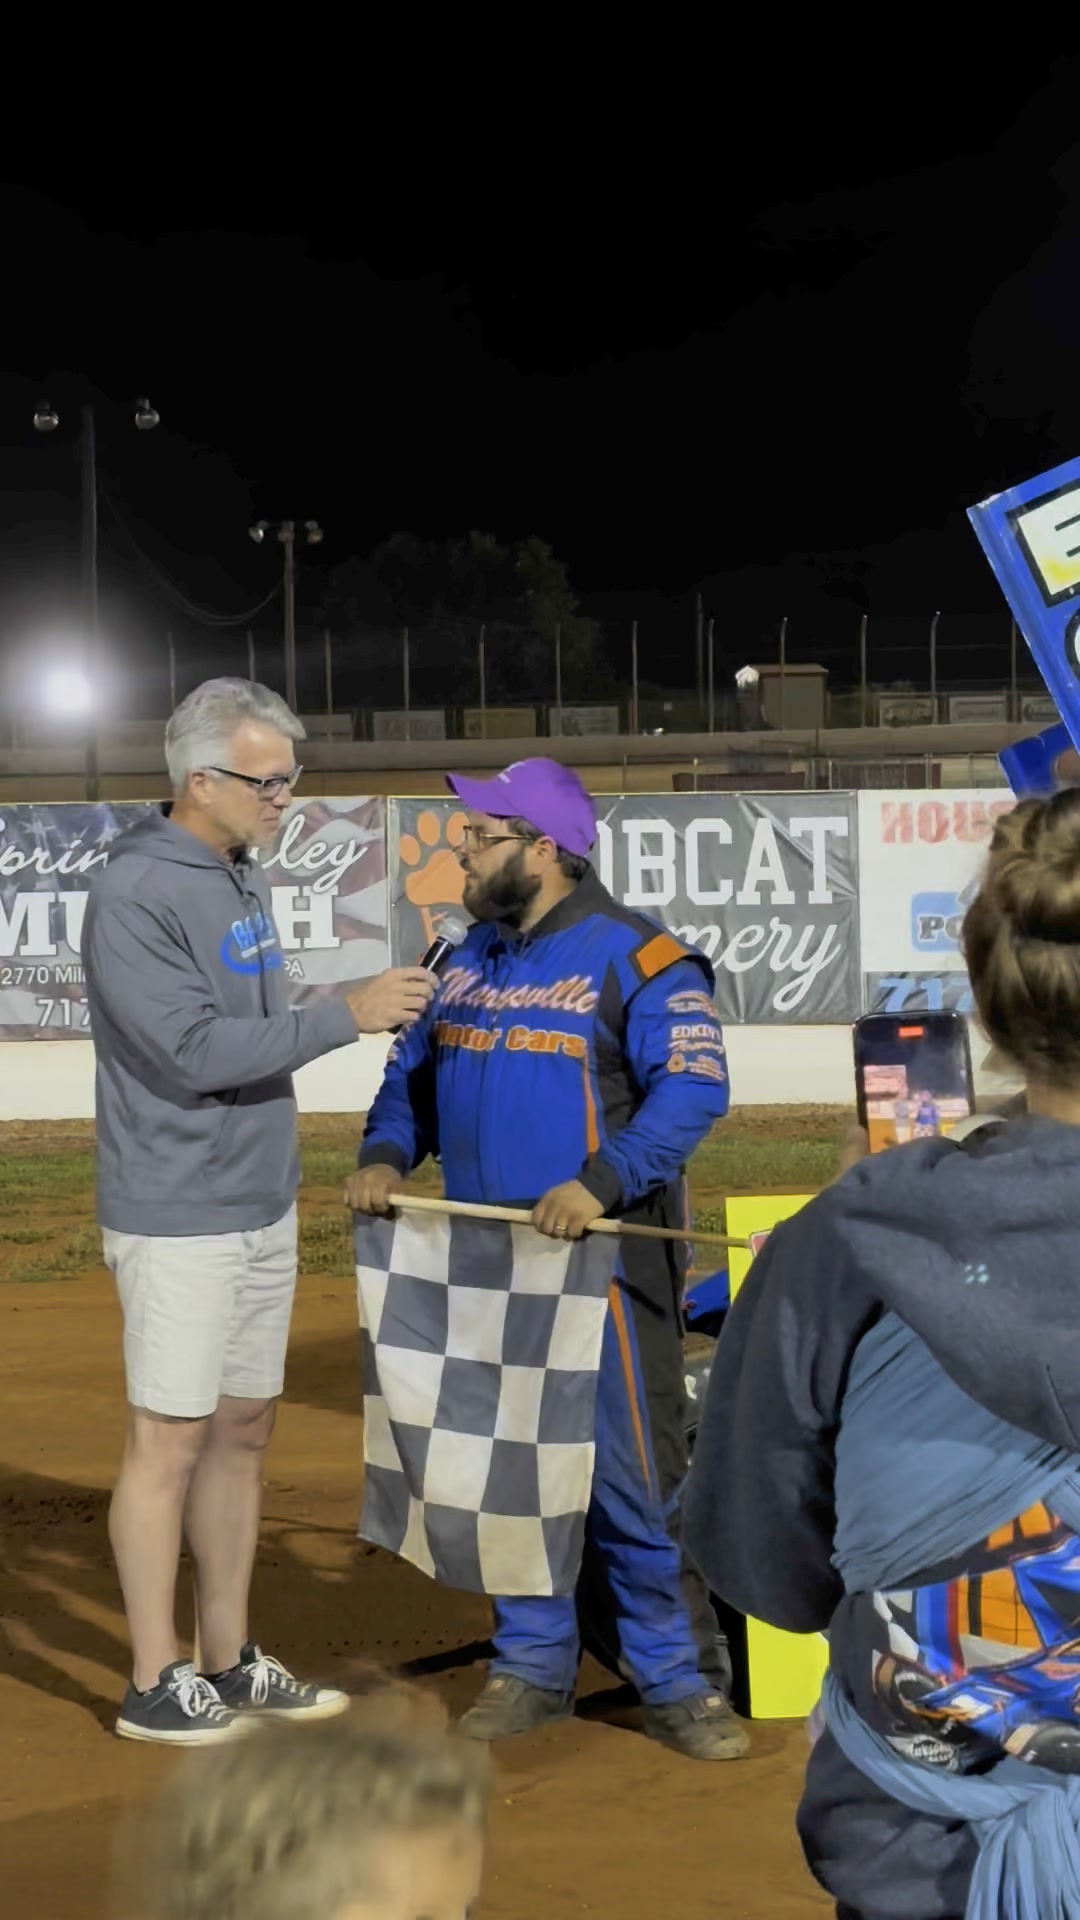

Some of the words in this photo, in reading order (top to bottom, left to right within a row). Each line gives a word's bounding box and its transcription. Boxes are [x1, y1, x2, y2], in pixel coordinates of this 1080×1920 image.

[262, 814, 369, 893] ley
[1, 966, 49, 985] 2770
[505, 1024, 587, 1058] Cars
